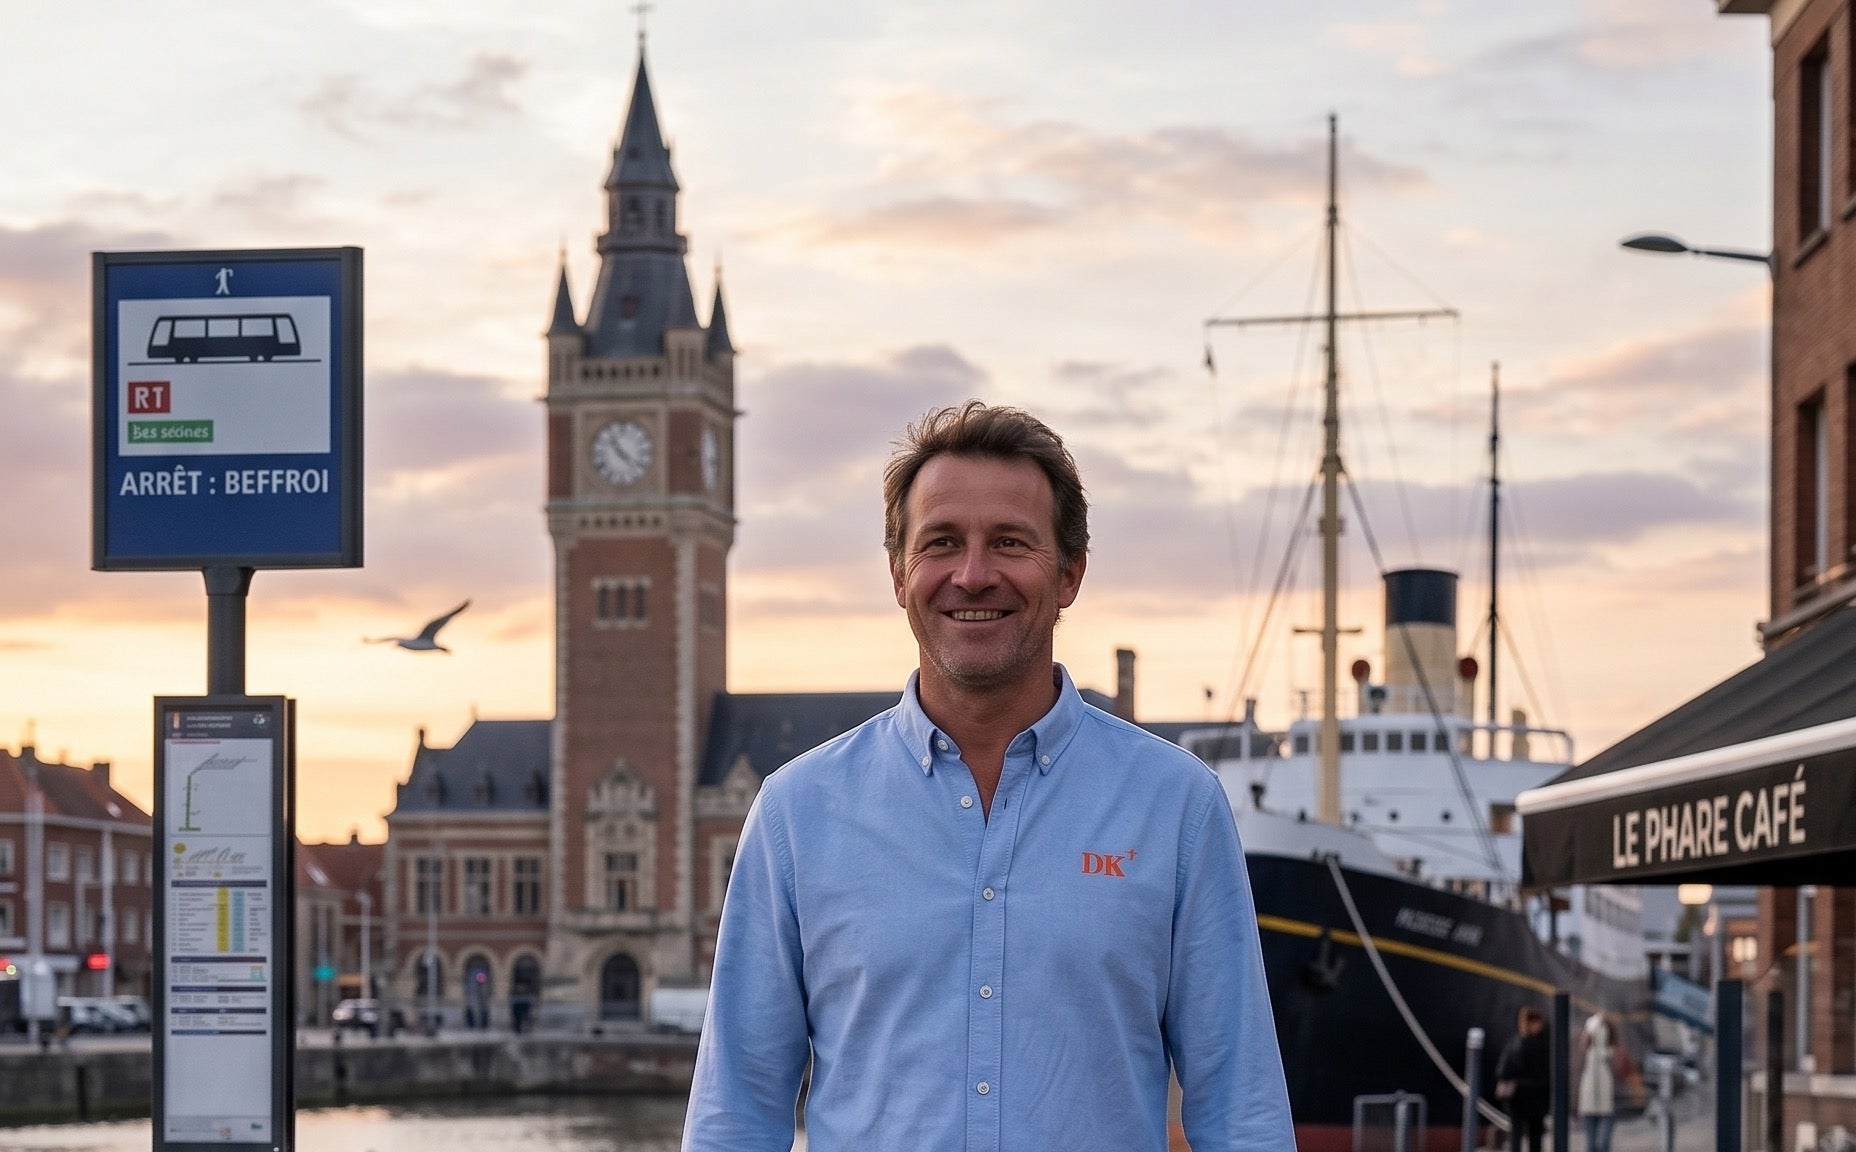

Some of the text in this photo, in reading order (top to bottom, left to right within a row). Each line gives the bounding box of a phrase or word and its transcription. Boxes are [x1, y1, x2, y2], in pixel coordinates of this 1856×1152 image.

[134, 386, 164, 409] RT
[119, 464, 203, 496] ARRÊT
[224, 469, 329, 495] BEFFROI
[1612, 763, 1807, 869] LE PHARE CAFÉ
